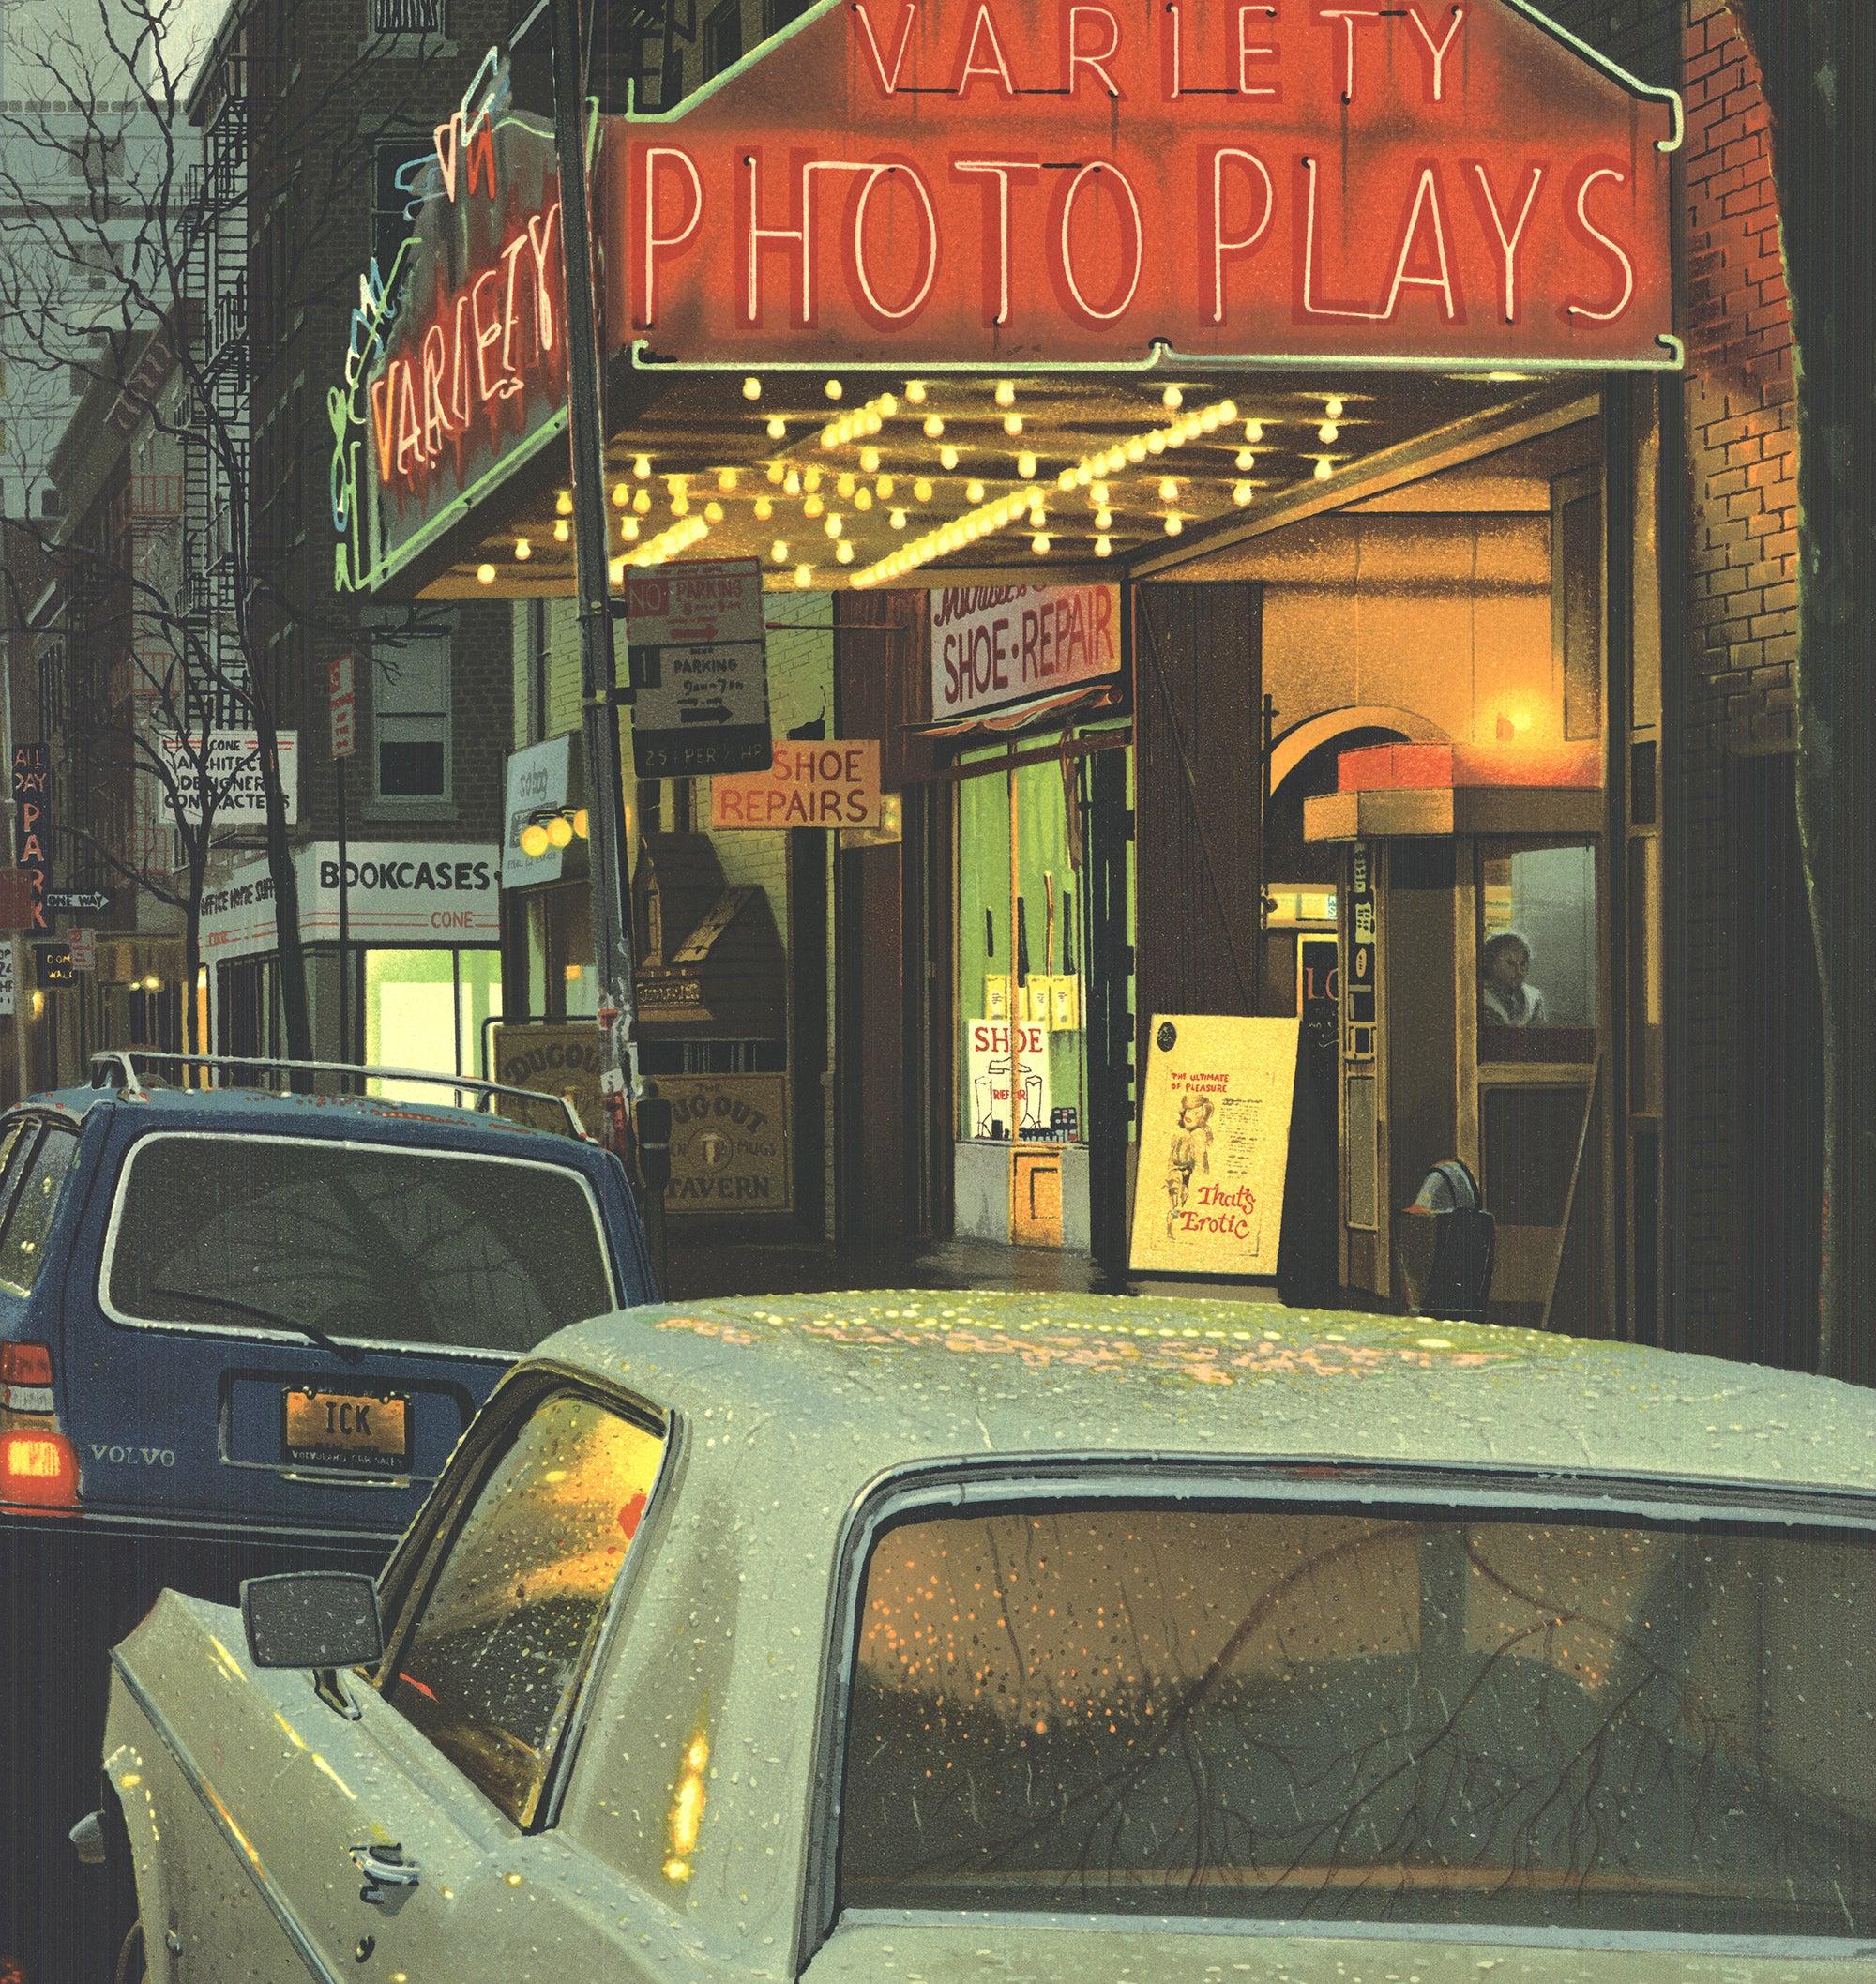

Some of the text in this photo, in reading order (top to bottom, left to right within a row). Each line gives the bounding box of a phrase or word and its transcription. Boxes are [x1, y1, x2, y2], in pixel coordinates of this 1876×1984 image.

[848, 1, 1469, 104] VARIETY
[632, 142, 1637, 332] PHOTO PLAYS
[371, 204, 562, 483] VARIETY
[629, 584, 661, 613] NO
[673, 657, 738, 674] PARKING
[210, 739, 241, 751] CONE
[685, 748, 716, 764] PER
[773, 750, 864, 783] SHOE
[181, 775, 265, 792] DEIGNER
[164, 793, 290, 810] CONACTES
[719, 789, 869, 823] REPAIRS
[320, 860, 491, 890] BOOKCASES
[48, 894, 103, 907] ONE WAY
[431, 910, 474, 930] CONE
[505, 1042, 602, 1086] DUGOU
[1171, 1072, 1230, 1083] THE ULTIMATE
[1171, 1083, 1228, 1093] OF PLEASURE
[993, 1088, 1027, 1101] REPIR
[673, 1093, 767, 1134] UGOUT
[667, 1177, 769, 1199] TAVERN
[1197, 1183, 1257, 1215] That's
[1179, 1211, 1250, 1239] Erotic
[325, 1401, 372, 1436] ICK
[88, 1444, 176, 1468] VOLVO
